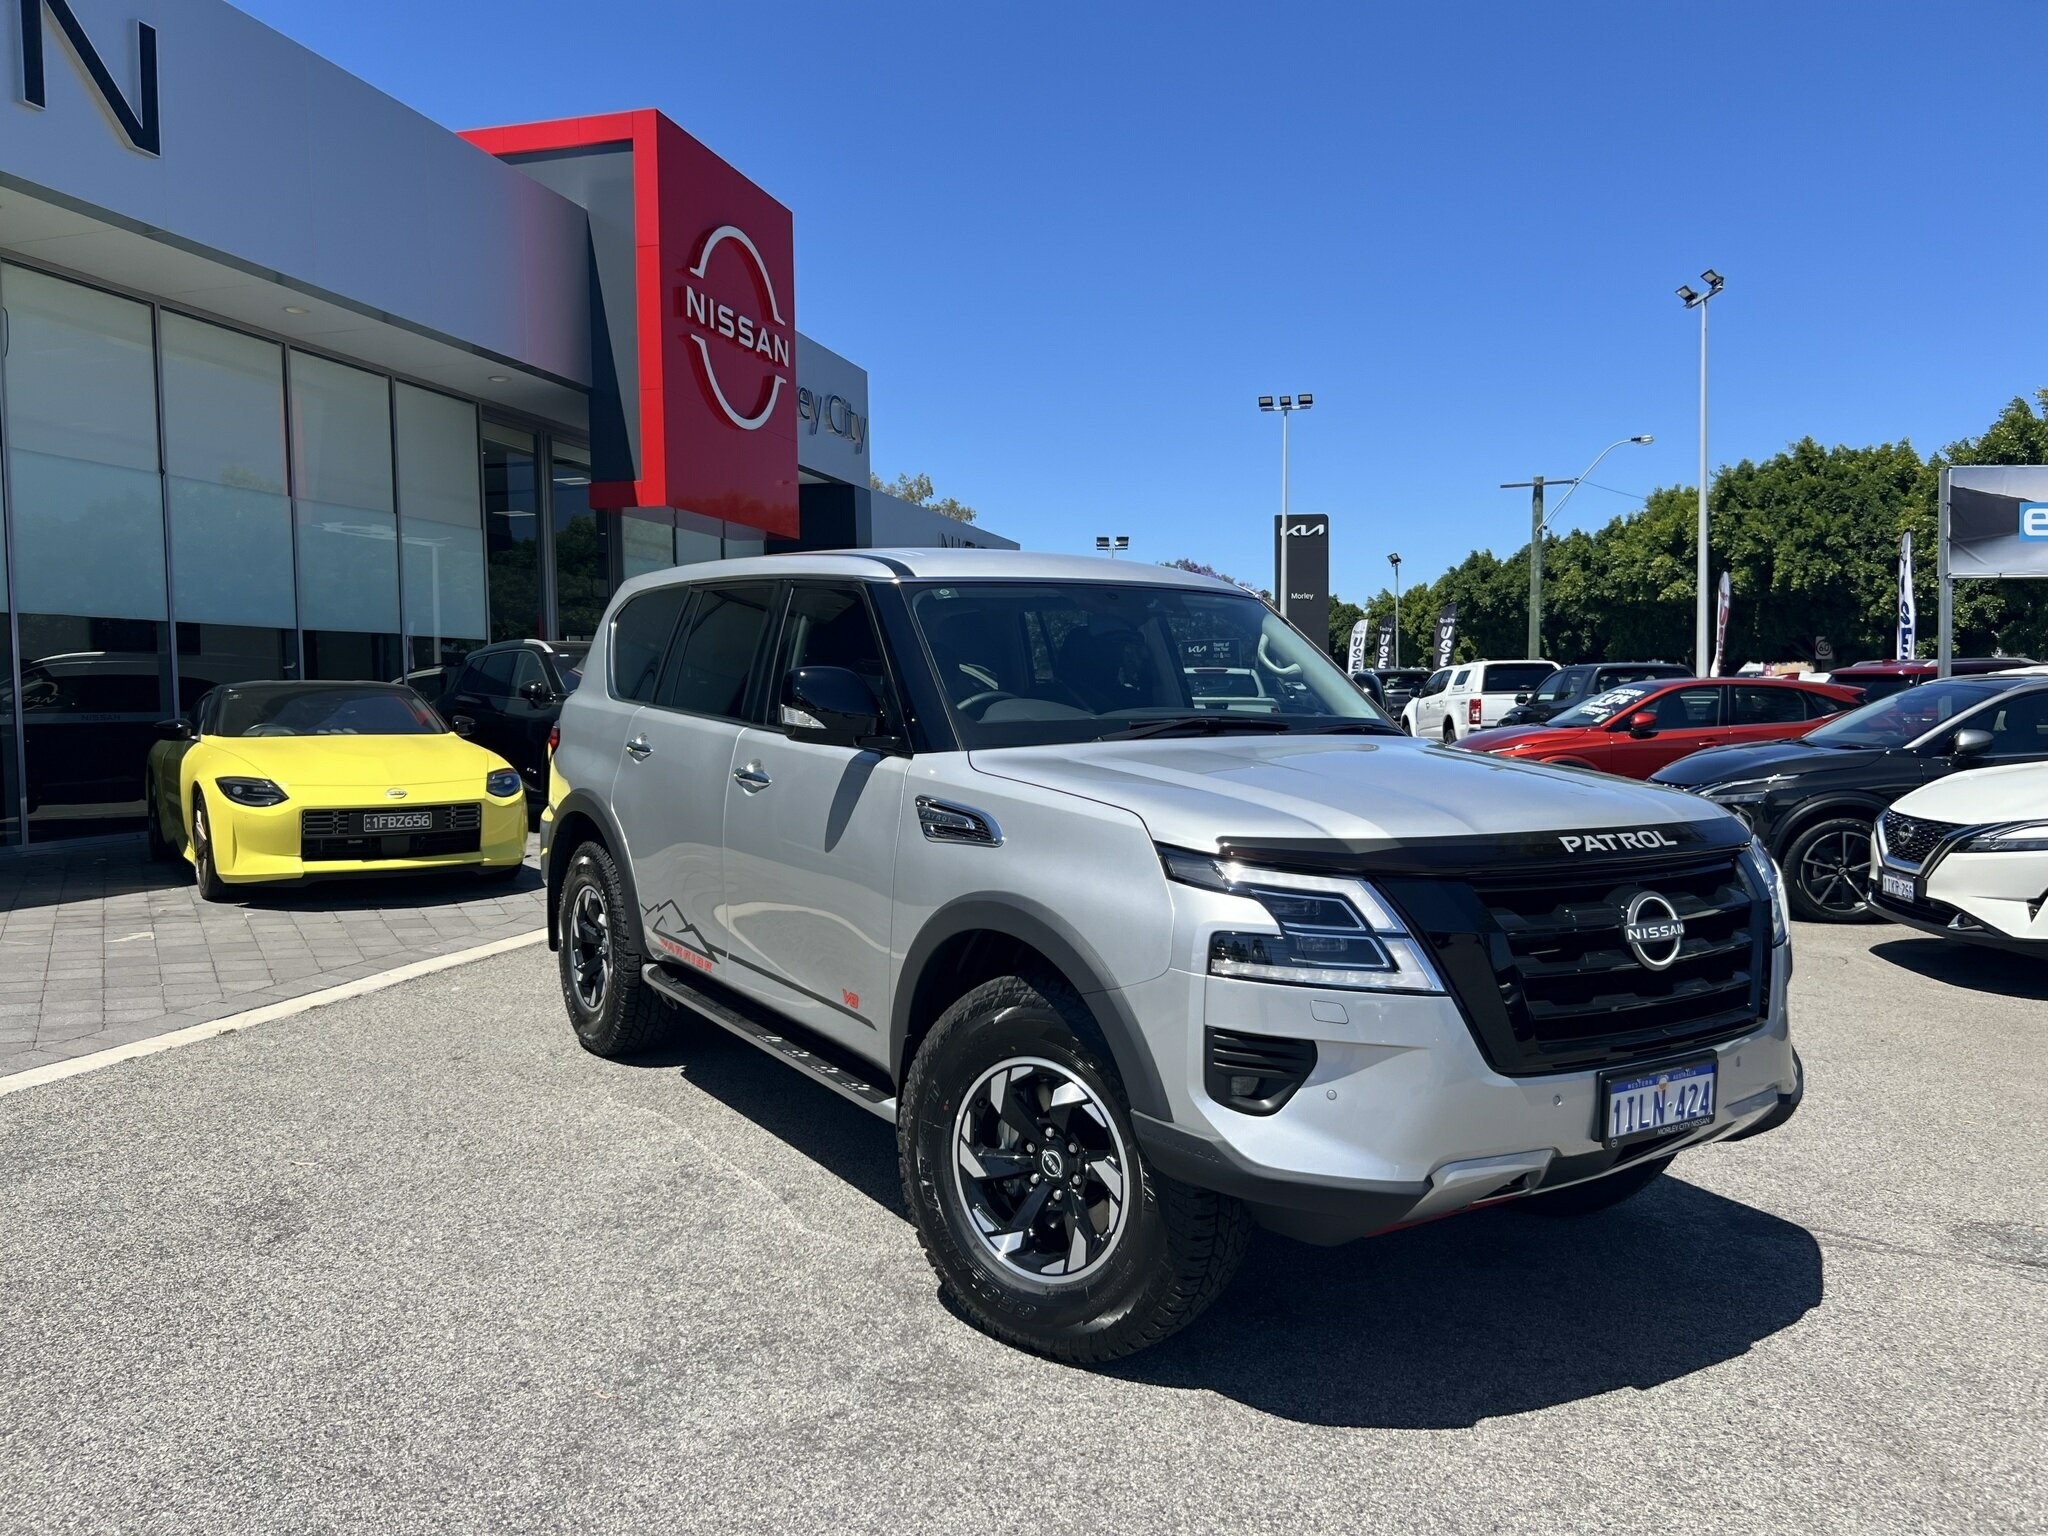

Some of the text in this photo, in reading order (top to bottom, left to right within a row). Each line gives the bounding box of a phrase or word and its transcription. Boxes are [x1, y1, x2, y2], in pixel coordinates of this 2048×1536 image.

[20, 0, 161, 159] N
[686, 285, 789, 368] NISSAN
[827, 394, 867, 455] City
[1280, 524, 1325, 536] KIA
[1290, 592, 1314, 601] Morley
[372, 815, 430, 828] 1FBZ656
[1558, 830, 1678, 853] PATROL
[1627, 923, 1685, 941] NISSAN
[1627, 1070, 1697, 1090] WESTERN AUSTRALIA
[1657, 1117, 1711, 1136] MORLEY CITY NISSAN
